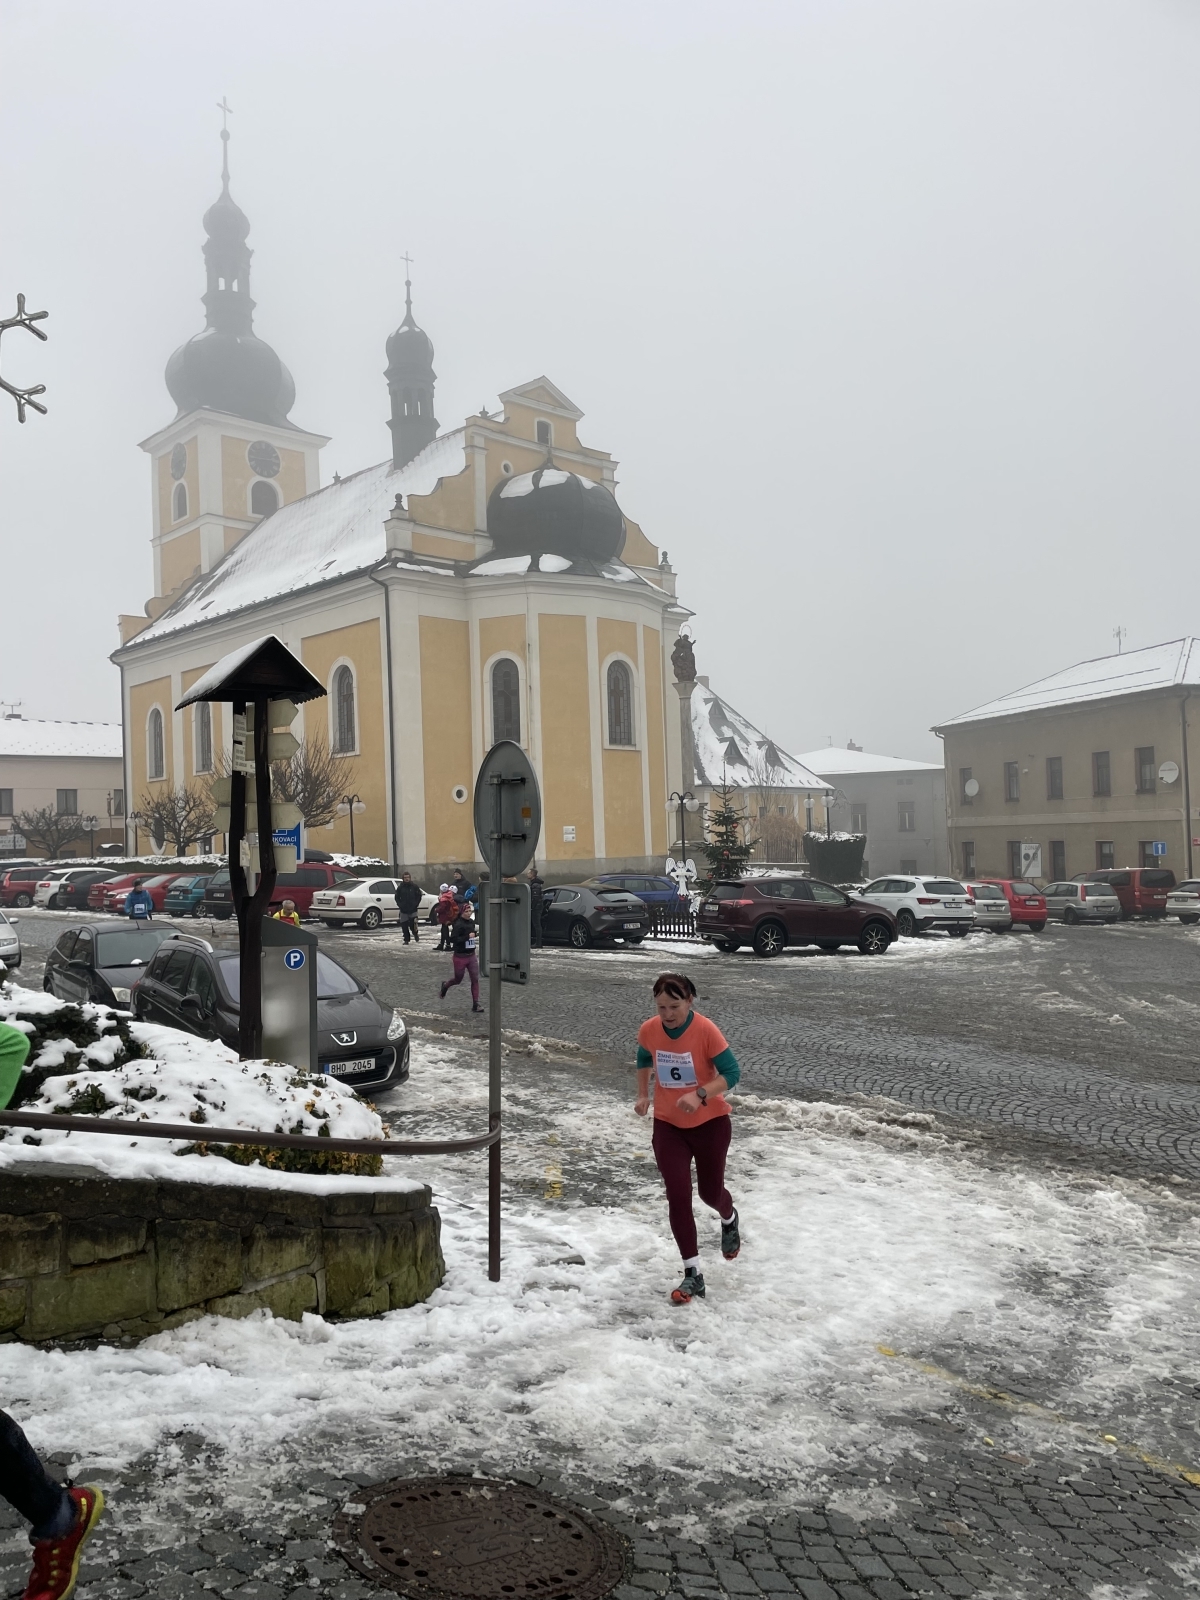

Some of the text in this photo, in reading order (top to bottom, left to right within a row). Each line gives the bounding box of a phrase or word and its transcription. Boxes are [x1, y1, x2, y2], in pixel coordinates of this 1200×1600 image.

[290, 953, 301, 966] P
[352, 1060, 372, 1071] 2045
[670, 1067, 682, 1081] 6
